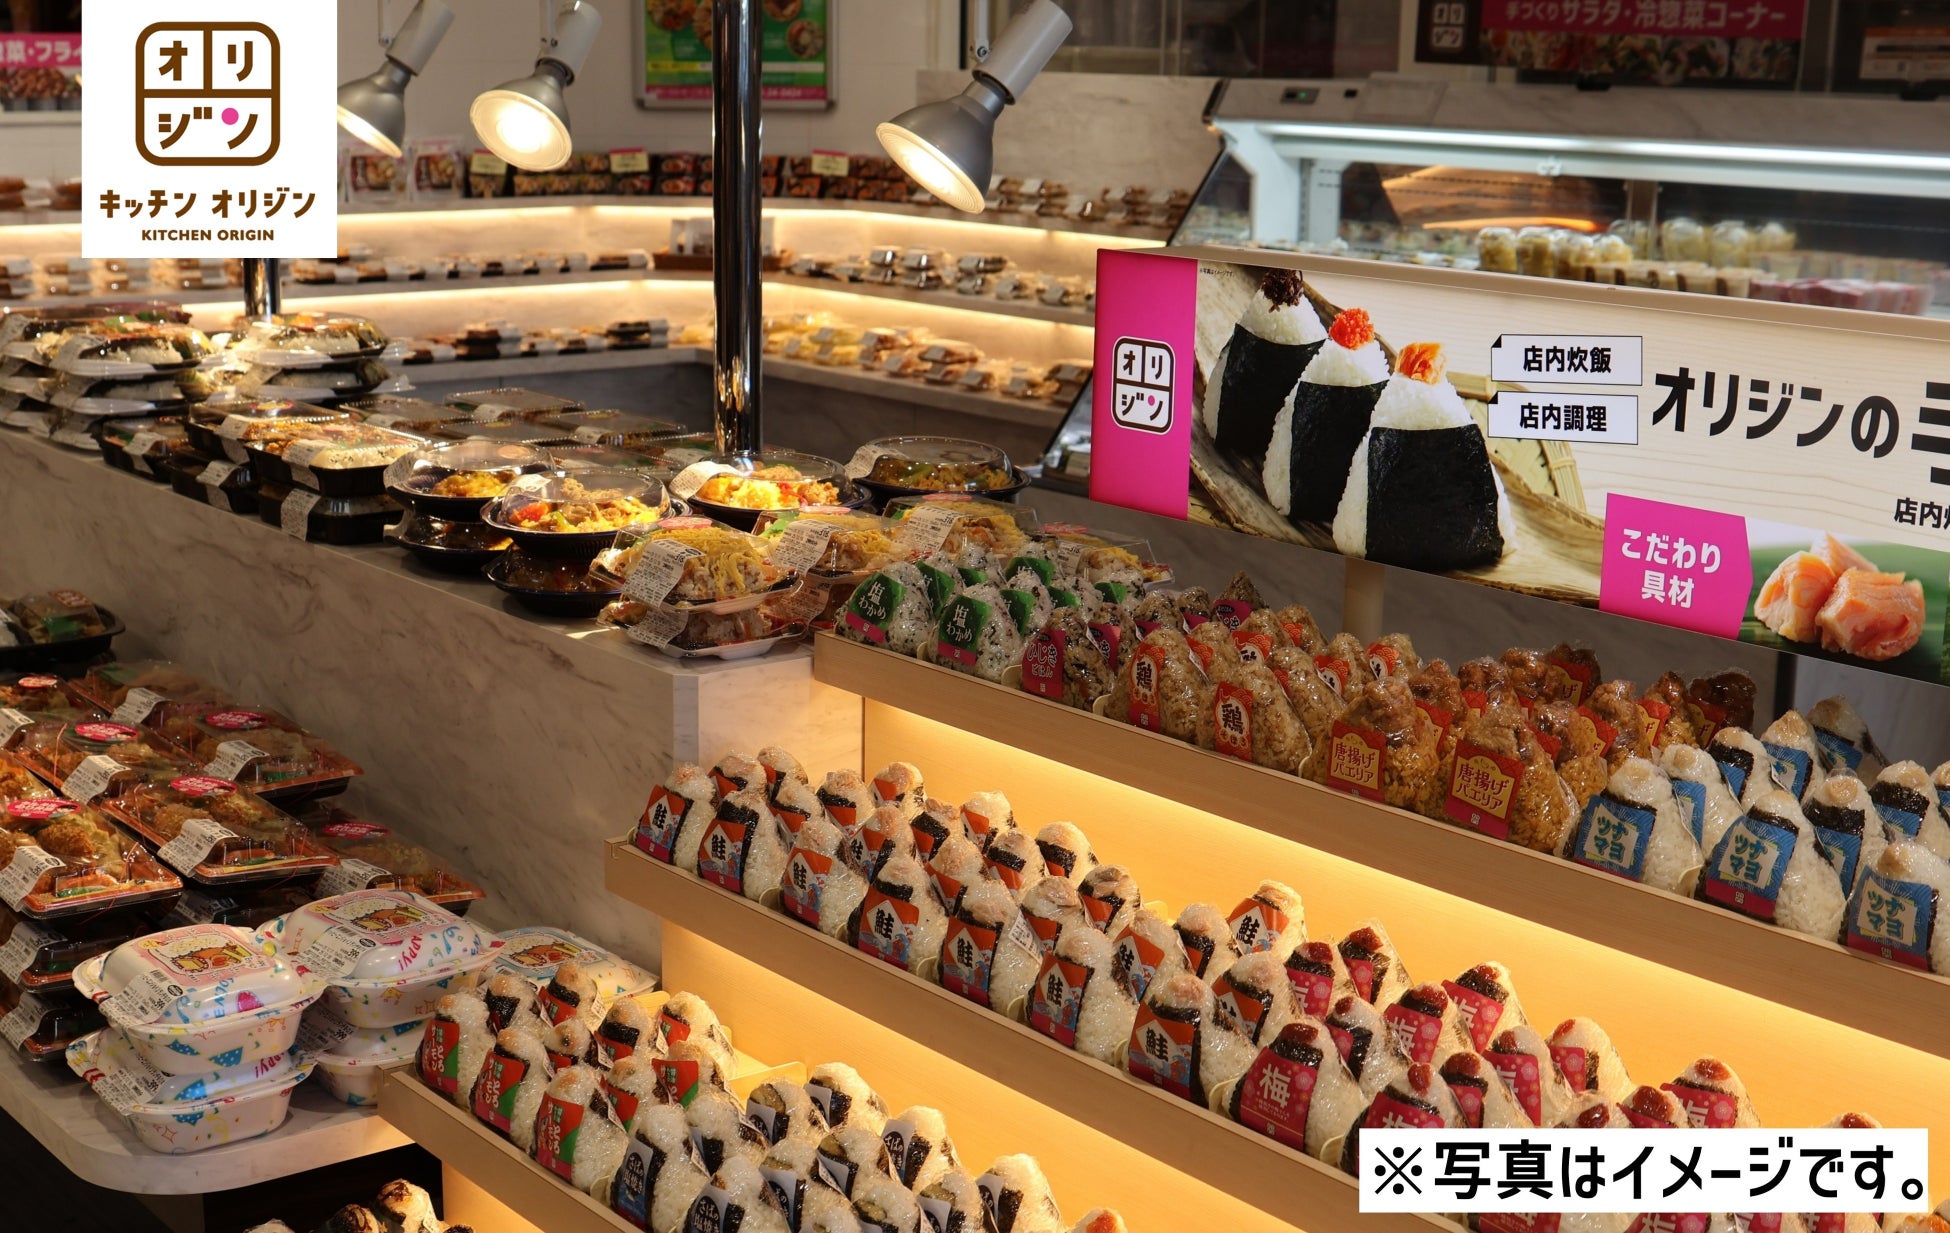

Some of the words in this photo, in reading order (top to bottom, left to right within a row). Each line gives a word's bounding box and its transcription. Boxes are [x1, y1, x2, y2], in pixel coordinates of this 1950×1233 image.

[1522, 345, 1612, 374] 店内炊飯
[1519, 402, 1608, 433] 店内調理
[1620, 527, 1722, 574] こだわり
[867, 581, 885, 605] 塩
[1641, 570, 1696, 609] 具材
[858, 596, 886, 619] わかめ
[953, 604, 969, 628] 塩
[945, 622, 974, 642] わかめ
[1027, 643, 1058, 668] ひじき
[1031, 663, 1054, 679] ごはん
[1221, 703, 1244, 735] 鶏
[1335, 742, 1376, 769] 唐揚げ
[1333, 762, 1374, 783] パエリア
[1458, 763, 1510, 796] 唐揚げ
[1456, 782, 1505, 810] パエリア
[1597, 815, 1628, 841] ツナ
[711, 834, 727, 862] 鮭
[1594, 835, 1626, 862] マヨ
[1734, 833, 1768, 861] ツナ
[1730, 854, 1763, 883] マヨ
[1867, 890, 1905, 917] ツナ
[874, 908, 895, 941] 鮭
[1236, 914, 1260, 946] 鮭
[1866, 910, 1904, 941] マヨ
[956, 937, 974, 968] 鮭
[1047, 974, 1063, 1008] 鮭
[1145, 1026, 1169, 1062] 鮭
[1260, 1063, 1291, 1109] 梅
[699, 1199, 719, 1221] さばの
